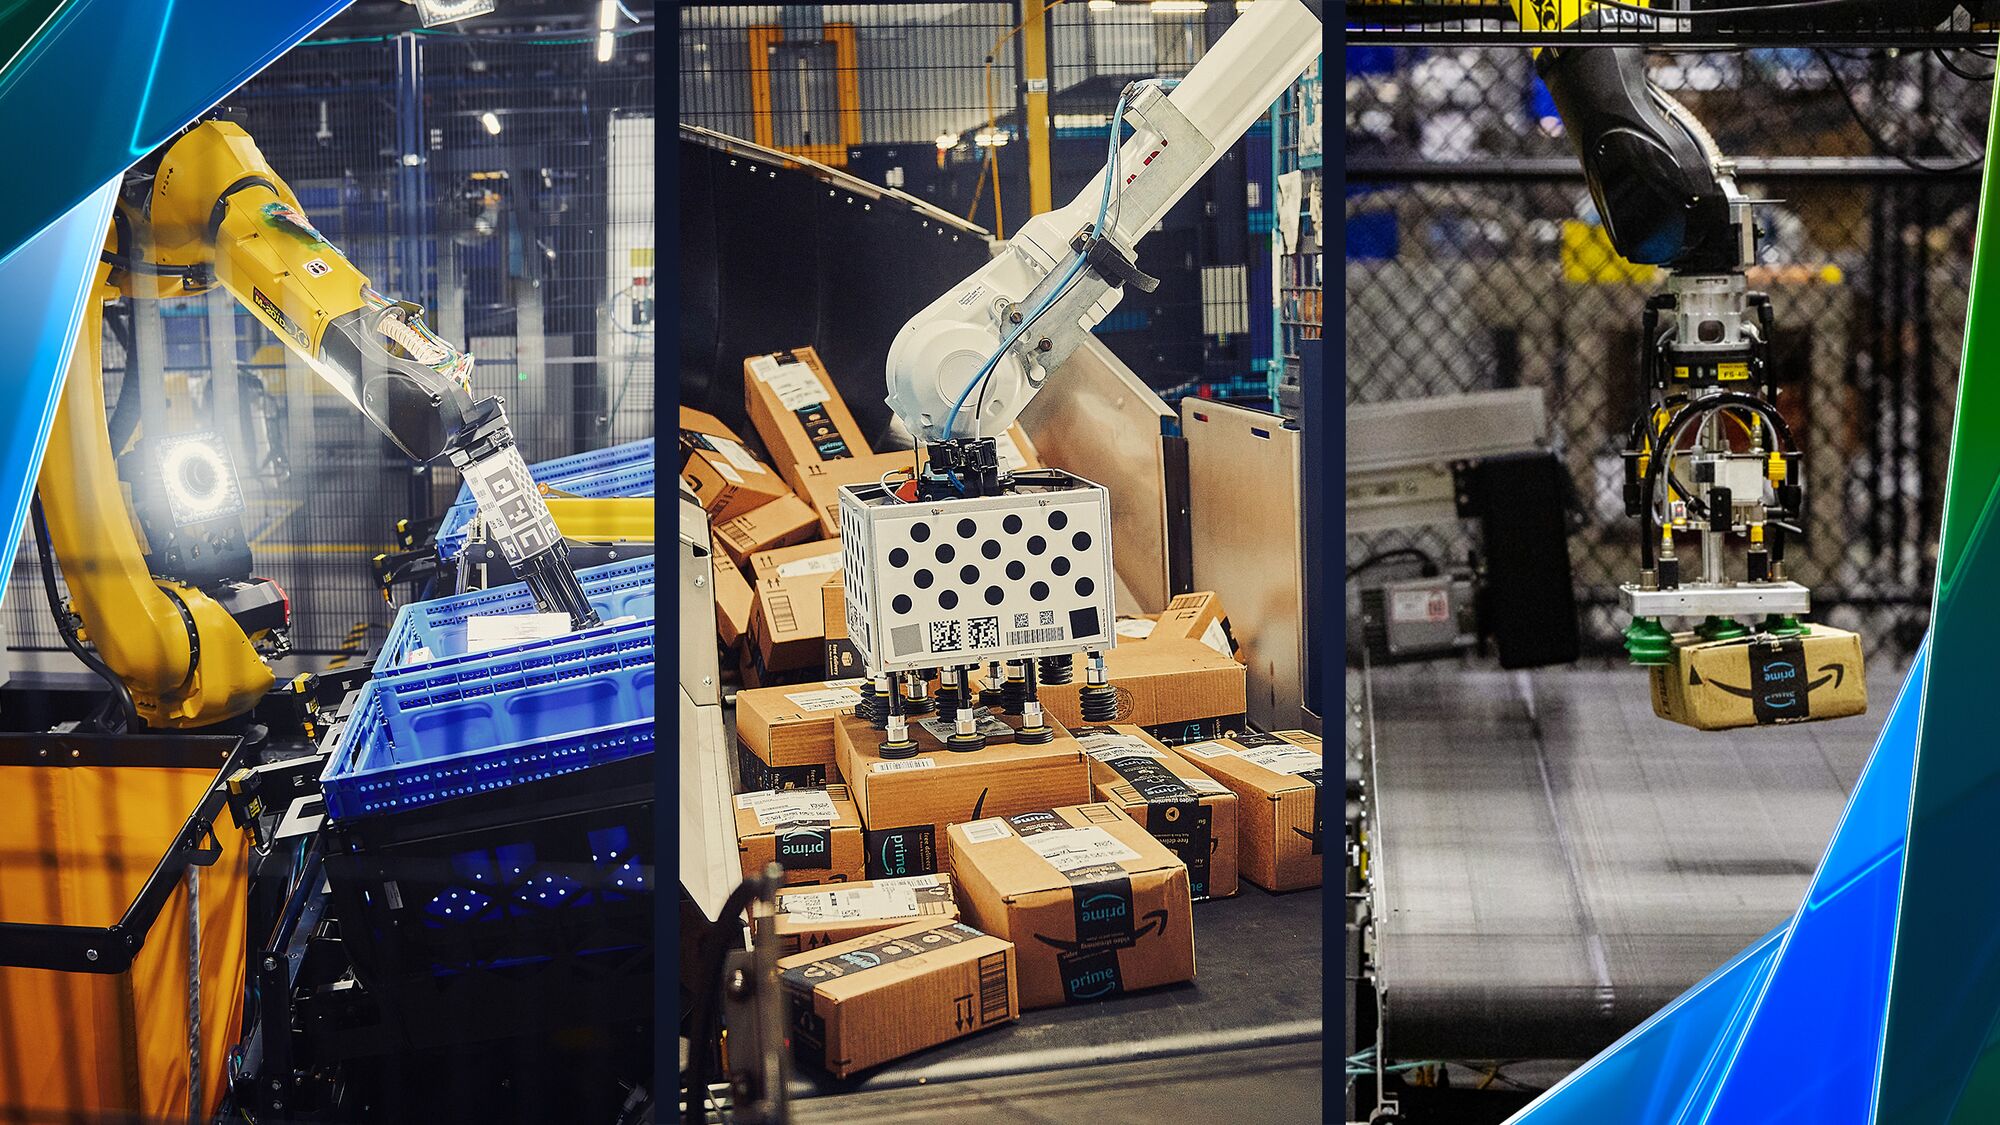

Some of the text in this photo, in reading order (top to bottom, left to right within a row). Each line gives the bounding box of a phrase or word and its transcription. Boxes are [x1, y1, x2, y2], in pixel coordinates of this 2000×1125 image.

[1764, 668, 1796, 682] prime
[782, 840, 825, 857] prime
[890, 834, 907, 874] prime
[1082, 903, 1126, 922] prime
[1070, 968, 1114, 993] prime
